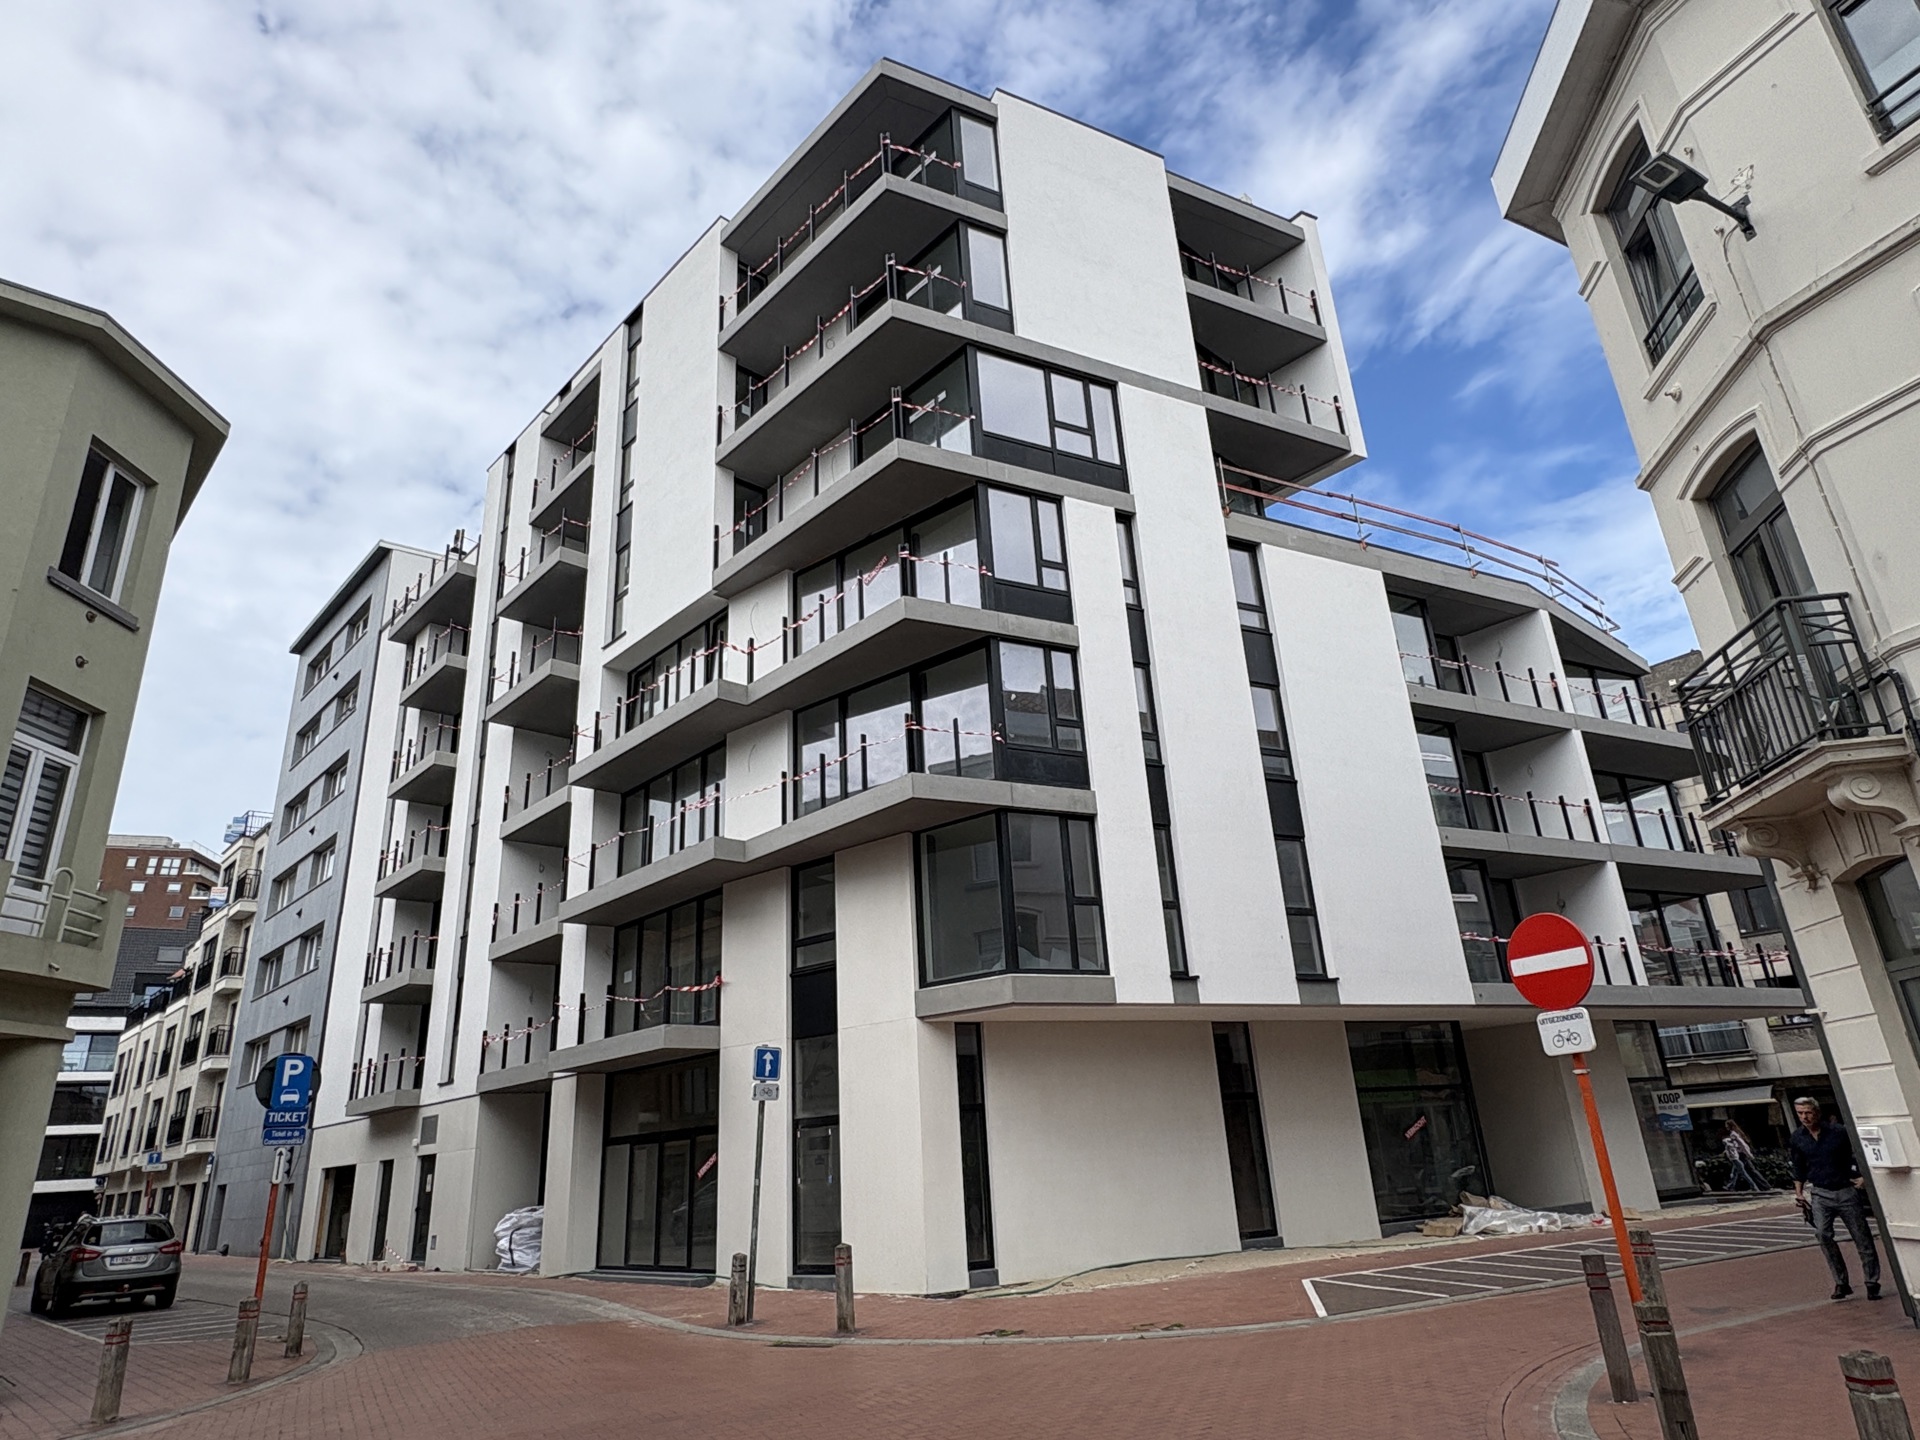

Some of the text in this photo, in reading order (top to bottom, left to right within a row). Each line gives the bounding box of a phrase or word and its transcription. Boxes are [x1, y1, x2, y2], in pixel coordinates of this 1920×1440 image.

[1538, 1012, 1584, 1026] UITGEZONDERD
[281, 1059, 305, 1087] P
[1656, 1093, 1681, 1105] KOOP
[268, 1111, 307, 1123] TICKET
[1872, 1147, 1883, 1161] 51
